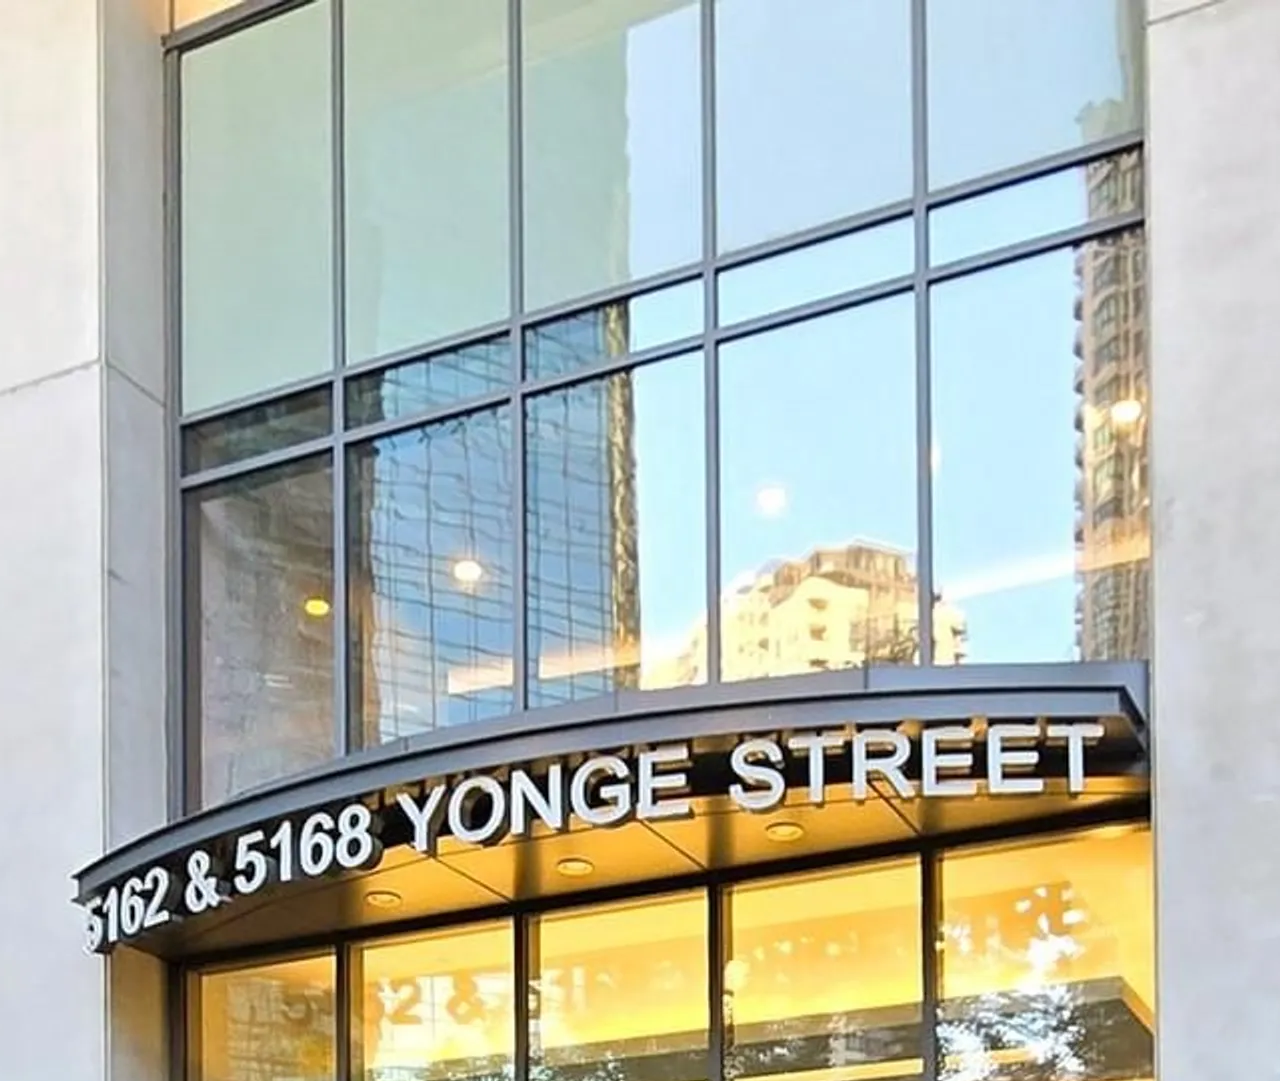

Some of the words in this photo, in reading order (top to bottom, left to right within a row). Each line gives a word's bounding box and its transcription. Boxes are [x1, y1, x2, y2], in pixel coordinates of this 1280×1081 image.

[82, 866, 170, 951] 5162
[184, 850, 223, 913] &
[233, 803, 373, 894] 5168
[395, 742, 690, 851] YONGE
[729, 723, 1104, 812] STREET
